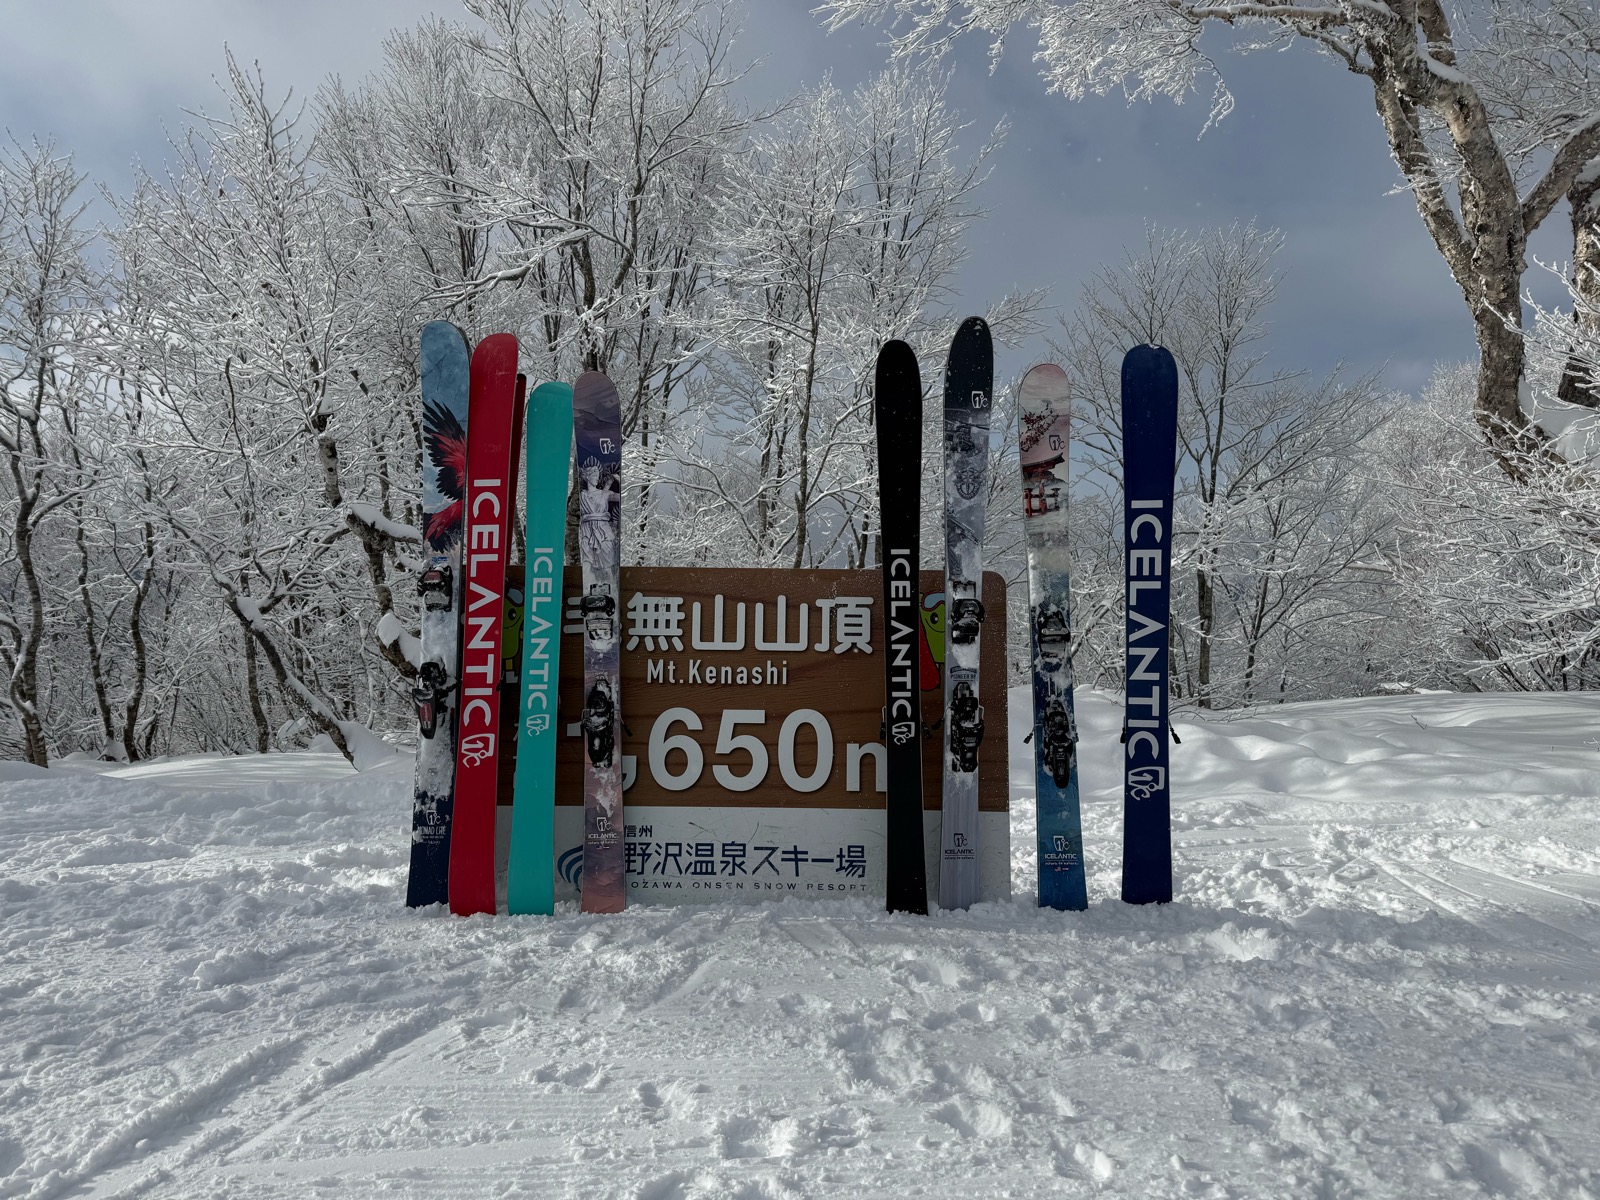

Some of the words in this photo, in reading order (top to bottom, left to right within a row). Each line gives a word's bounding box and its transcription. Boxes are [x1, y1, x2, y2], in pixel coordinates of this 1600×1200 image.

[463, 478, 501, 727] ICELANTIC
[527, 547, 554, 710] ICELANTIC
[890, 548, 917, 719] ICELANTIC
[1127, 499, 1167, 760] ICELANTIC
[647, 658, 788, 685] Mt.Kenashi
[624, 825, 653, 838] 信州
[624, 841, 867, 878] 野沢温泉スキー場
[630, 881, 683, 889] OZAWA
[753, 882, 797, 890] SNOW
[806, 883, 867, 892] RESORT
